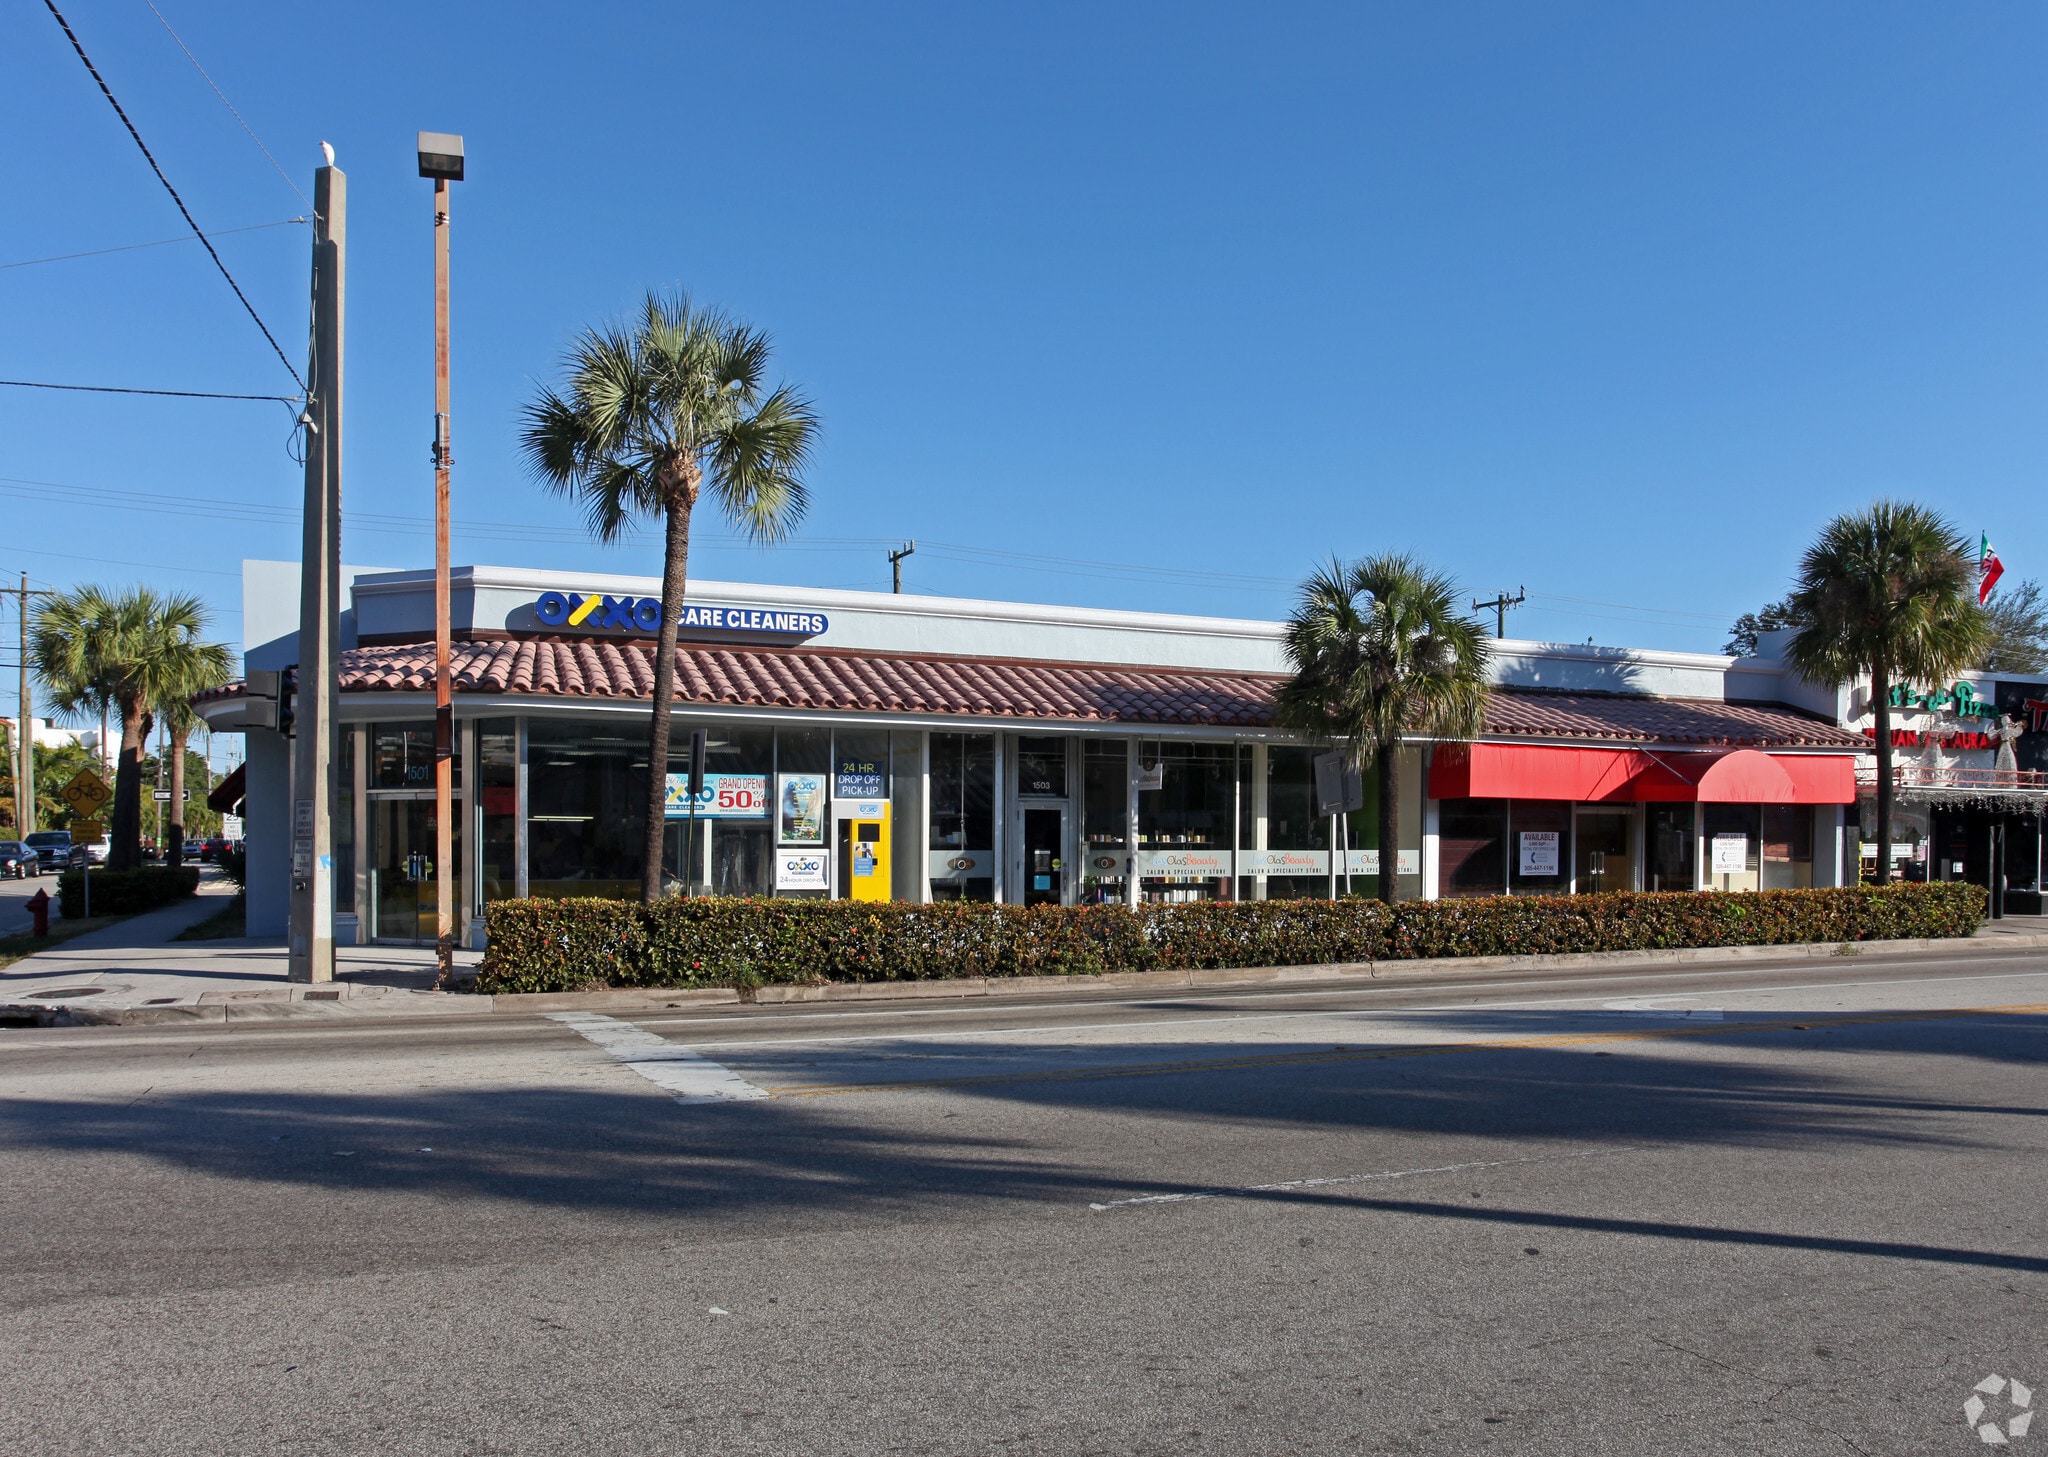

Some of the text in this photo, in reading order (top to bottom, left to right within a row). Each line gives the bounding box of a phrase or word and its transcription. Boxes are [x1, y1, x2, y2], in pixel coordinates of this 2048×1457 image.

[536, 591, 824, 632] OXXO CARE CLEANERS
[2022, 698, 2048, 733] T
[407, 764, 429, 780] 1501
[843, 763, 878, 774] 24 HR.
[718, 777, 741, 789] GRAND
[839, 775, 881, 785] DROP OFF
[1033, 781, 1051, 790] 1503
[842, 785, 878, 796] PICK-UP
[718, 790, 752, 809] 50
[1523, 833, 1556, 841] AVAILABLE
[787, 861, 819, 871] OXXO
